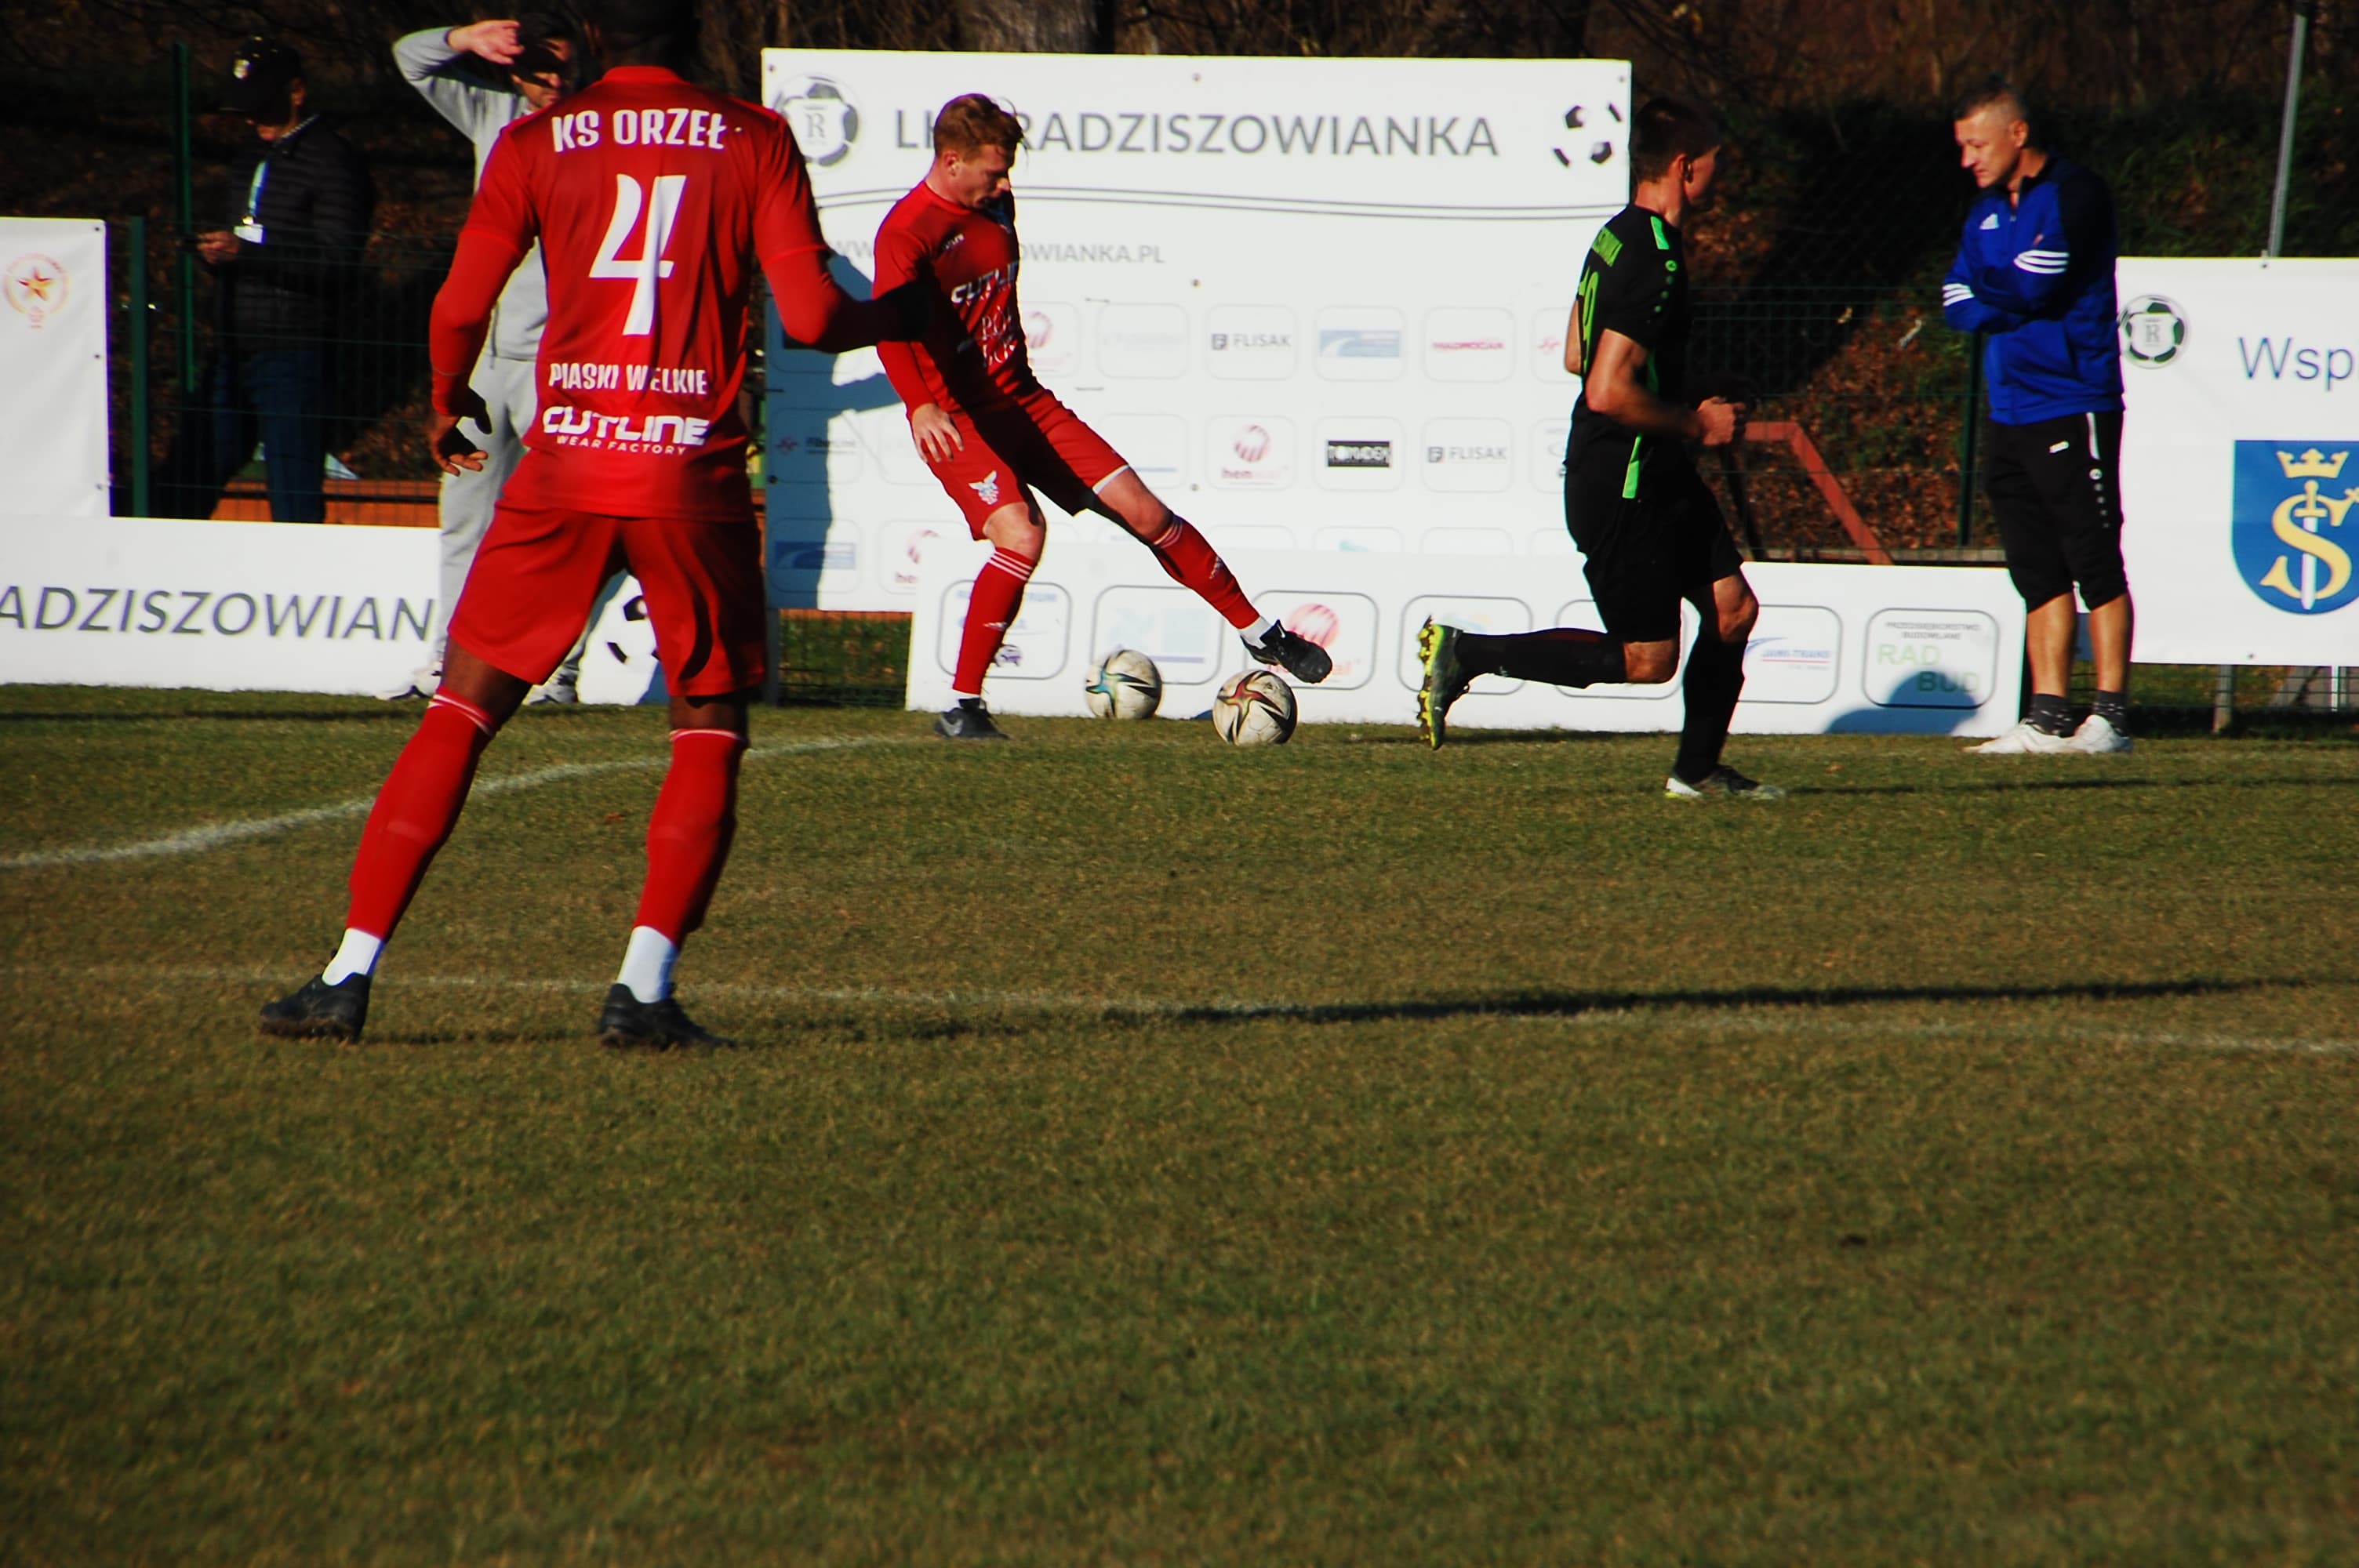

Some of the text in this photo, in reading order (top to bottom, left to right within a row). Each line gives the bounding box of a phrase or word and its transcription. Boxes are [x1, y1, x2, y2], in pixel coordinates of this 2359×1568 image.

[552, 107, 726, 153] KS ORZEŁ
[590, 172, 687, 336] 4
[1233, 333, 1292, 348] FLISAK
[549, 362, 619, 390] PIASKI
[2238, 336, 2355, 392] Wsp
[543, 405, 711, 446] CUTLINE
[556, 434, 686, 456] WEAR FACTORY
[1449, 445, 1508, 462] FLISAK
[0, 585, 434, 642] ADZISZOWIAN
[1877, 642, 1941, 666] RAD
[1917, 670, 1980, 694] BUD
